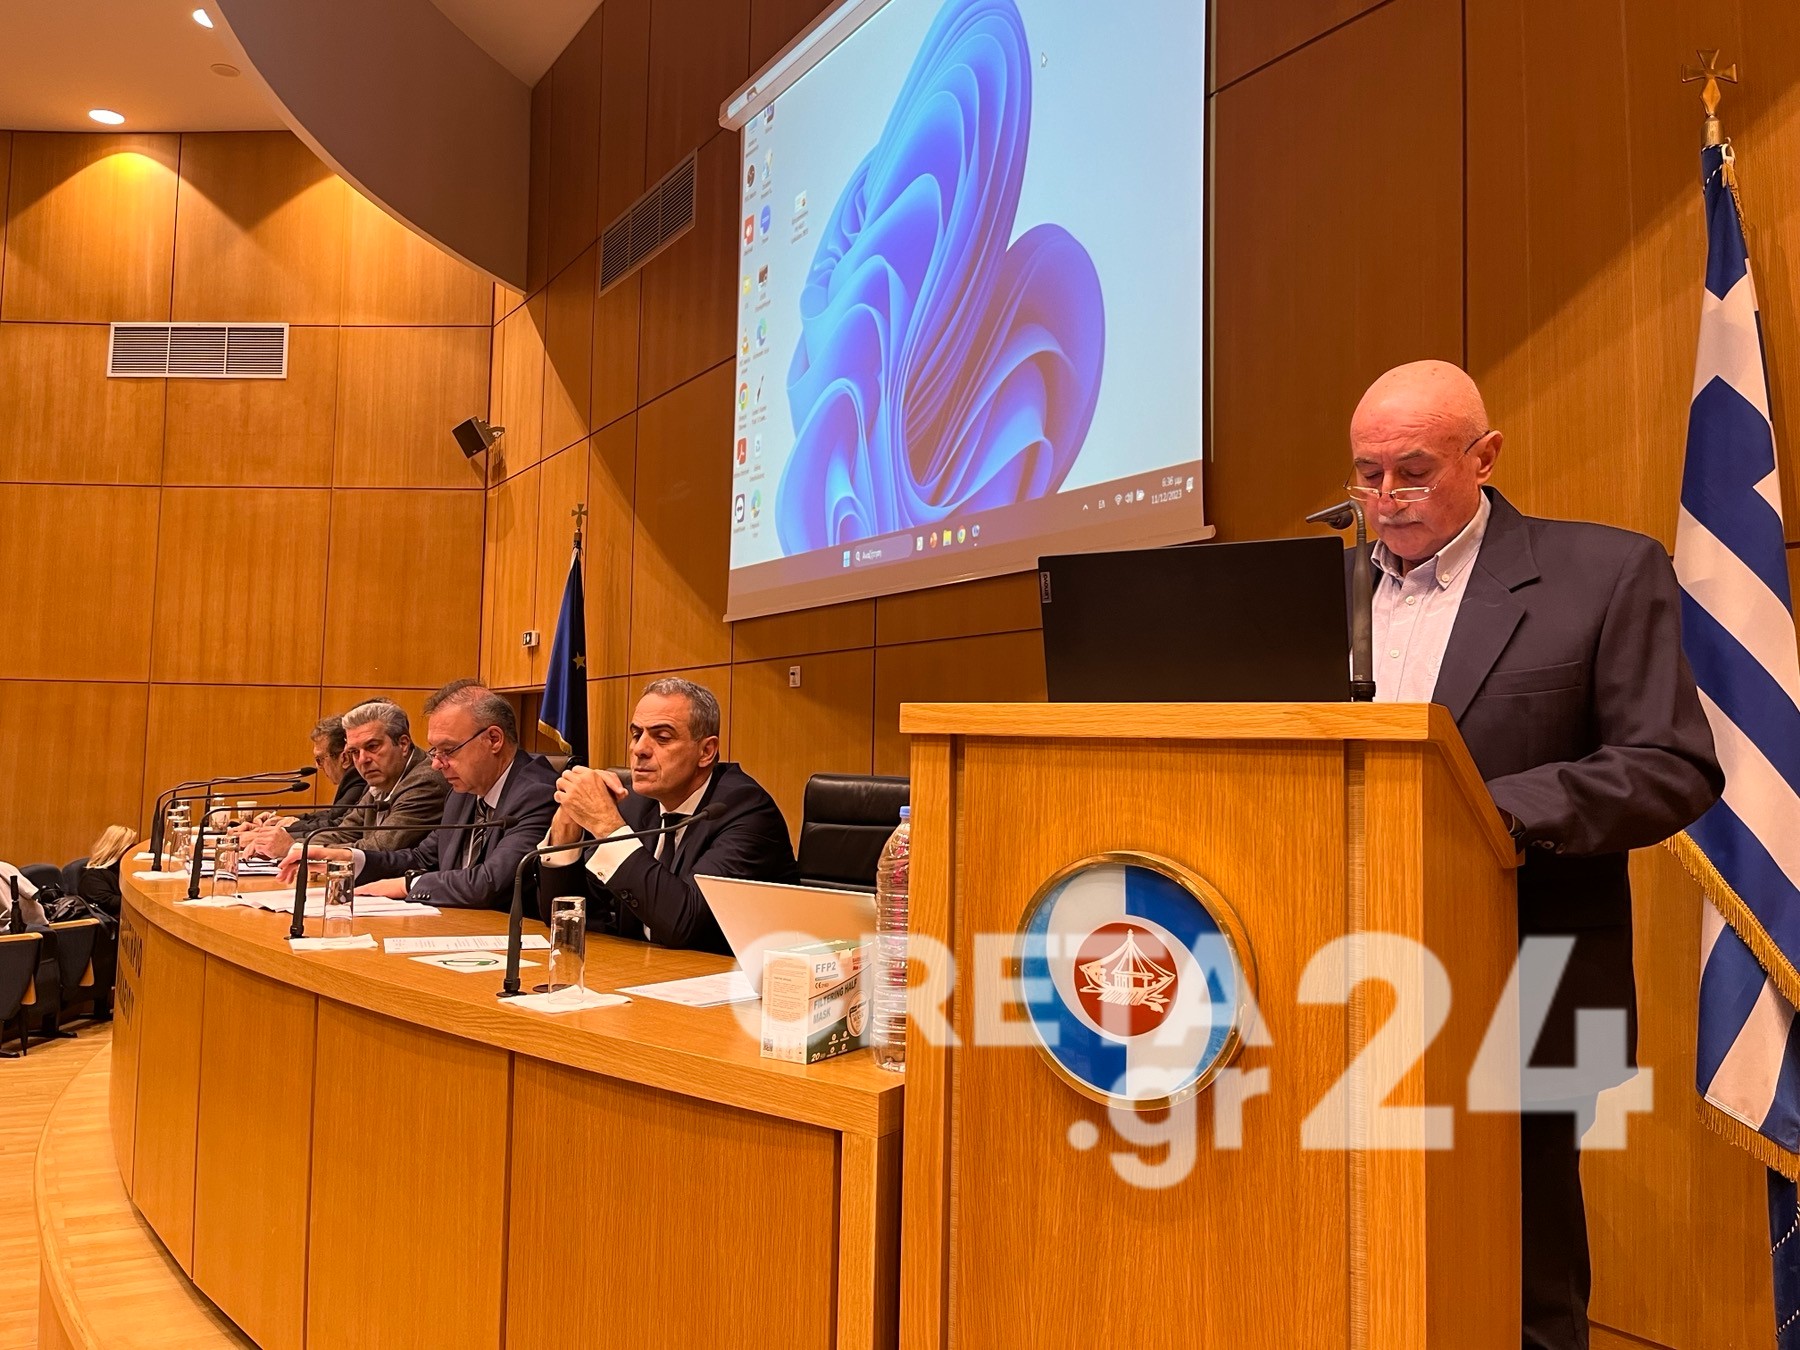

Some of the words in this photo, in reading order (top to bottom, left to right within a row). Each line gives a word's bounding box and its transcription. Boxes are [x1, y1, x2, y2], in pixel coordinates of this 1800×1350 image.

[815, 961, 837, 973] FFP2
[814, 986, 844, 1010] FILTERING
[844, 978, 857, 994] HALF
[813, 1007, 831, 1024] MASK
